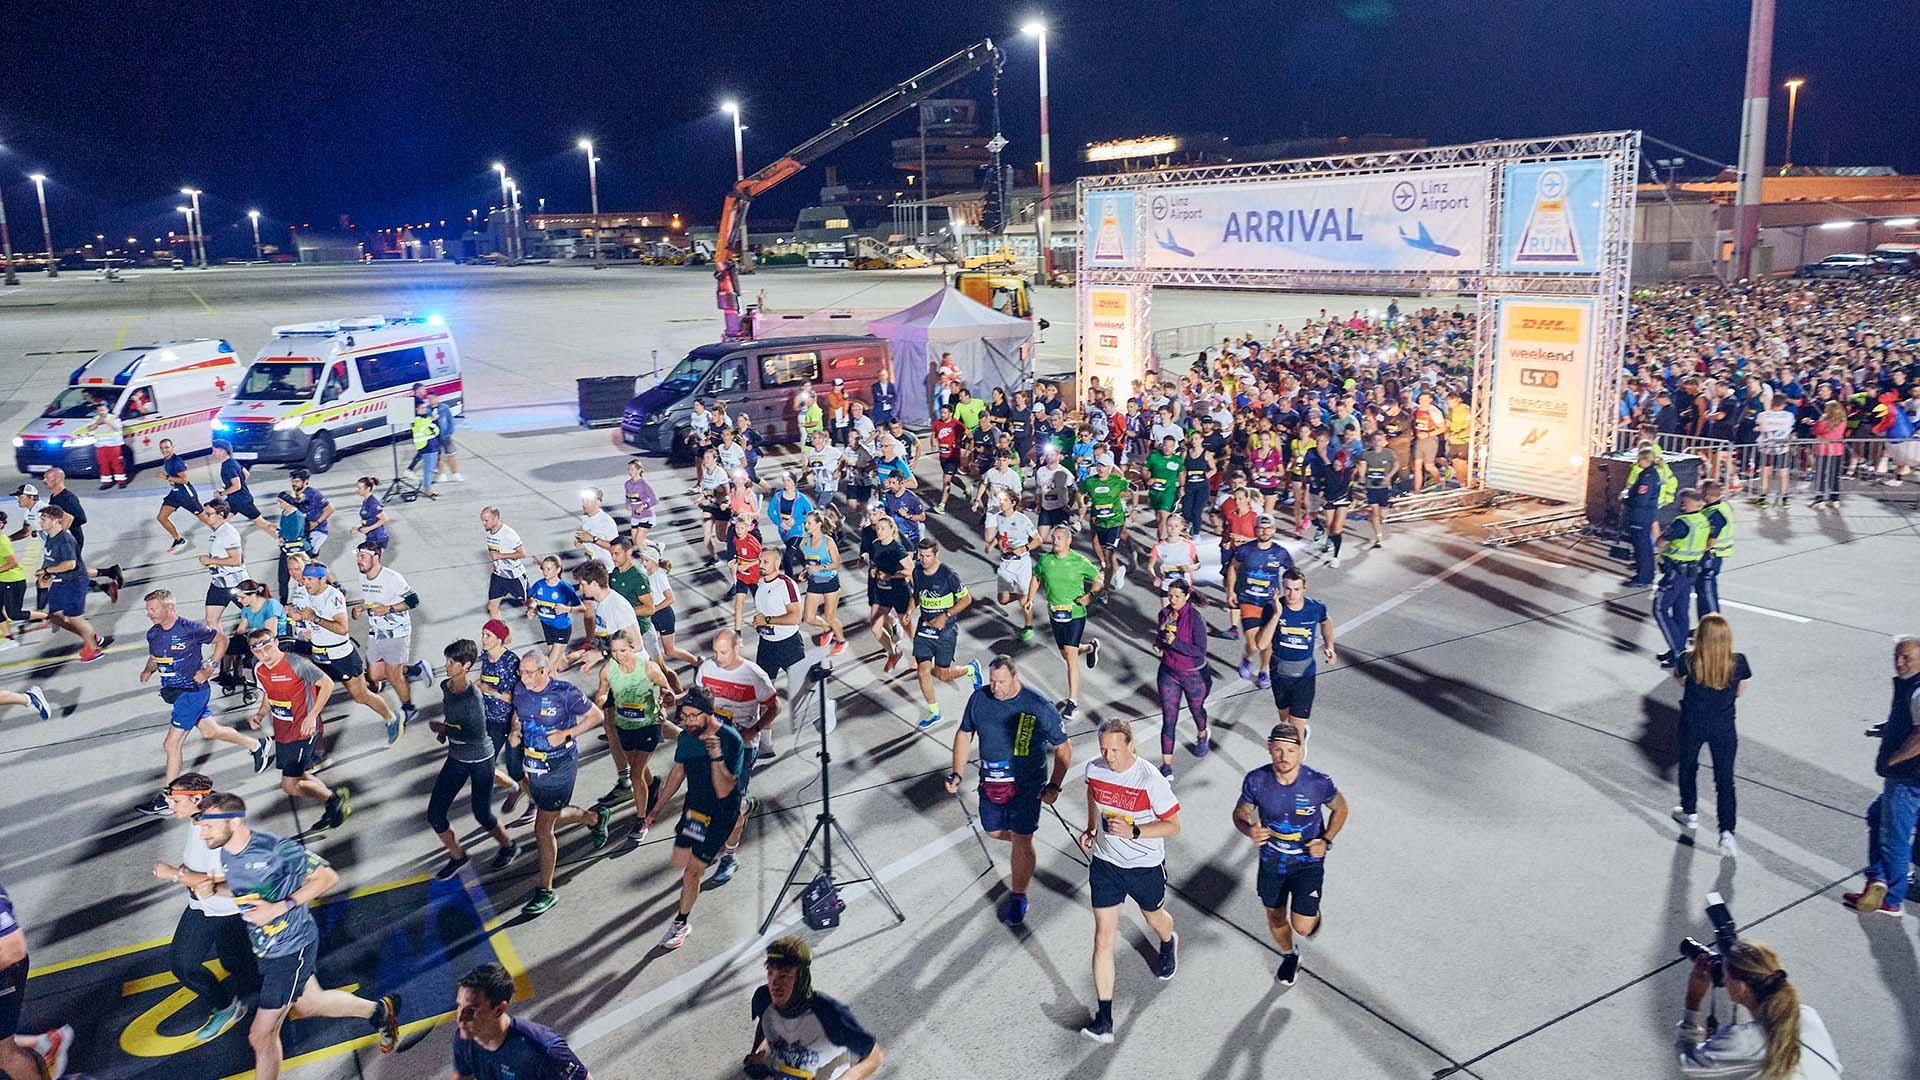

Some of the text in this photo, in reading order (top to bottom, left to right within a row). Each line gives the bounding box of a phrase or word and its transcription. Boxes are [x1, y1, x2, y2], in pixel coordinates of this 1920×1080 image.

[1421, 181, 1448, 195] Linz
[1170, 195, 1189, 207] Linz
[1420, 197, 1469, 213] Airport
[1170, 210, 1203, 222] Airport
[1222, 208, 1363, 243] ARRIVAL
[1529, 236, 1567, 252] RUN
[1520, 318, 1566, 331] DHL
[1510, 347, 1575, 363] weekend
[547, 707, 557, 716] 25
[1094, 787, 1138, 811] TEAM
